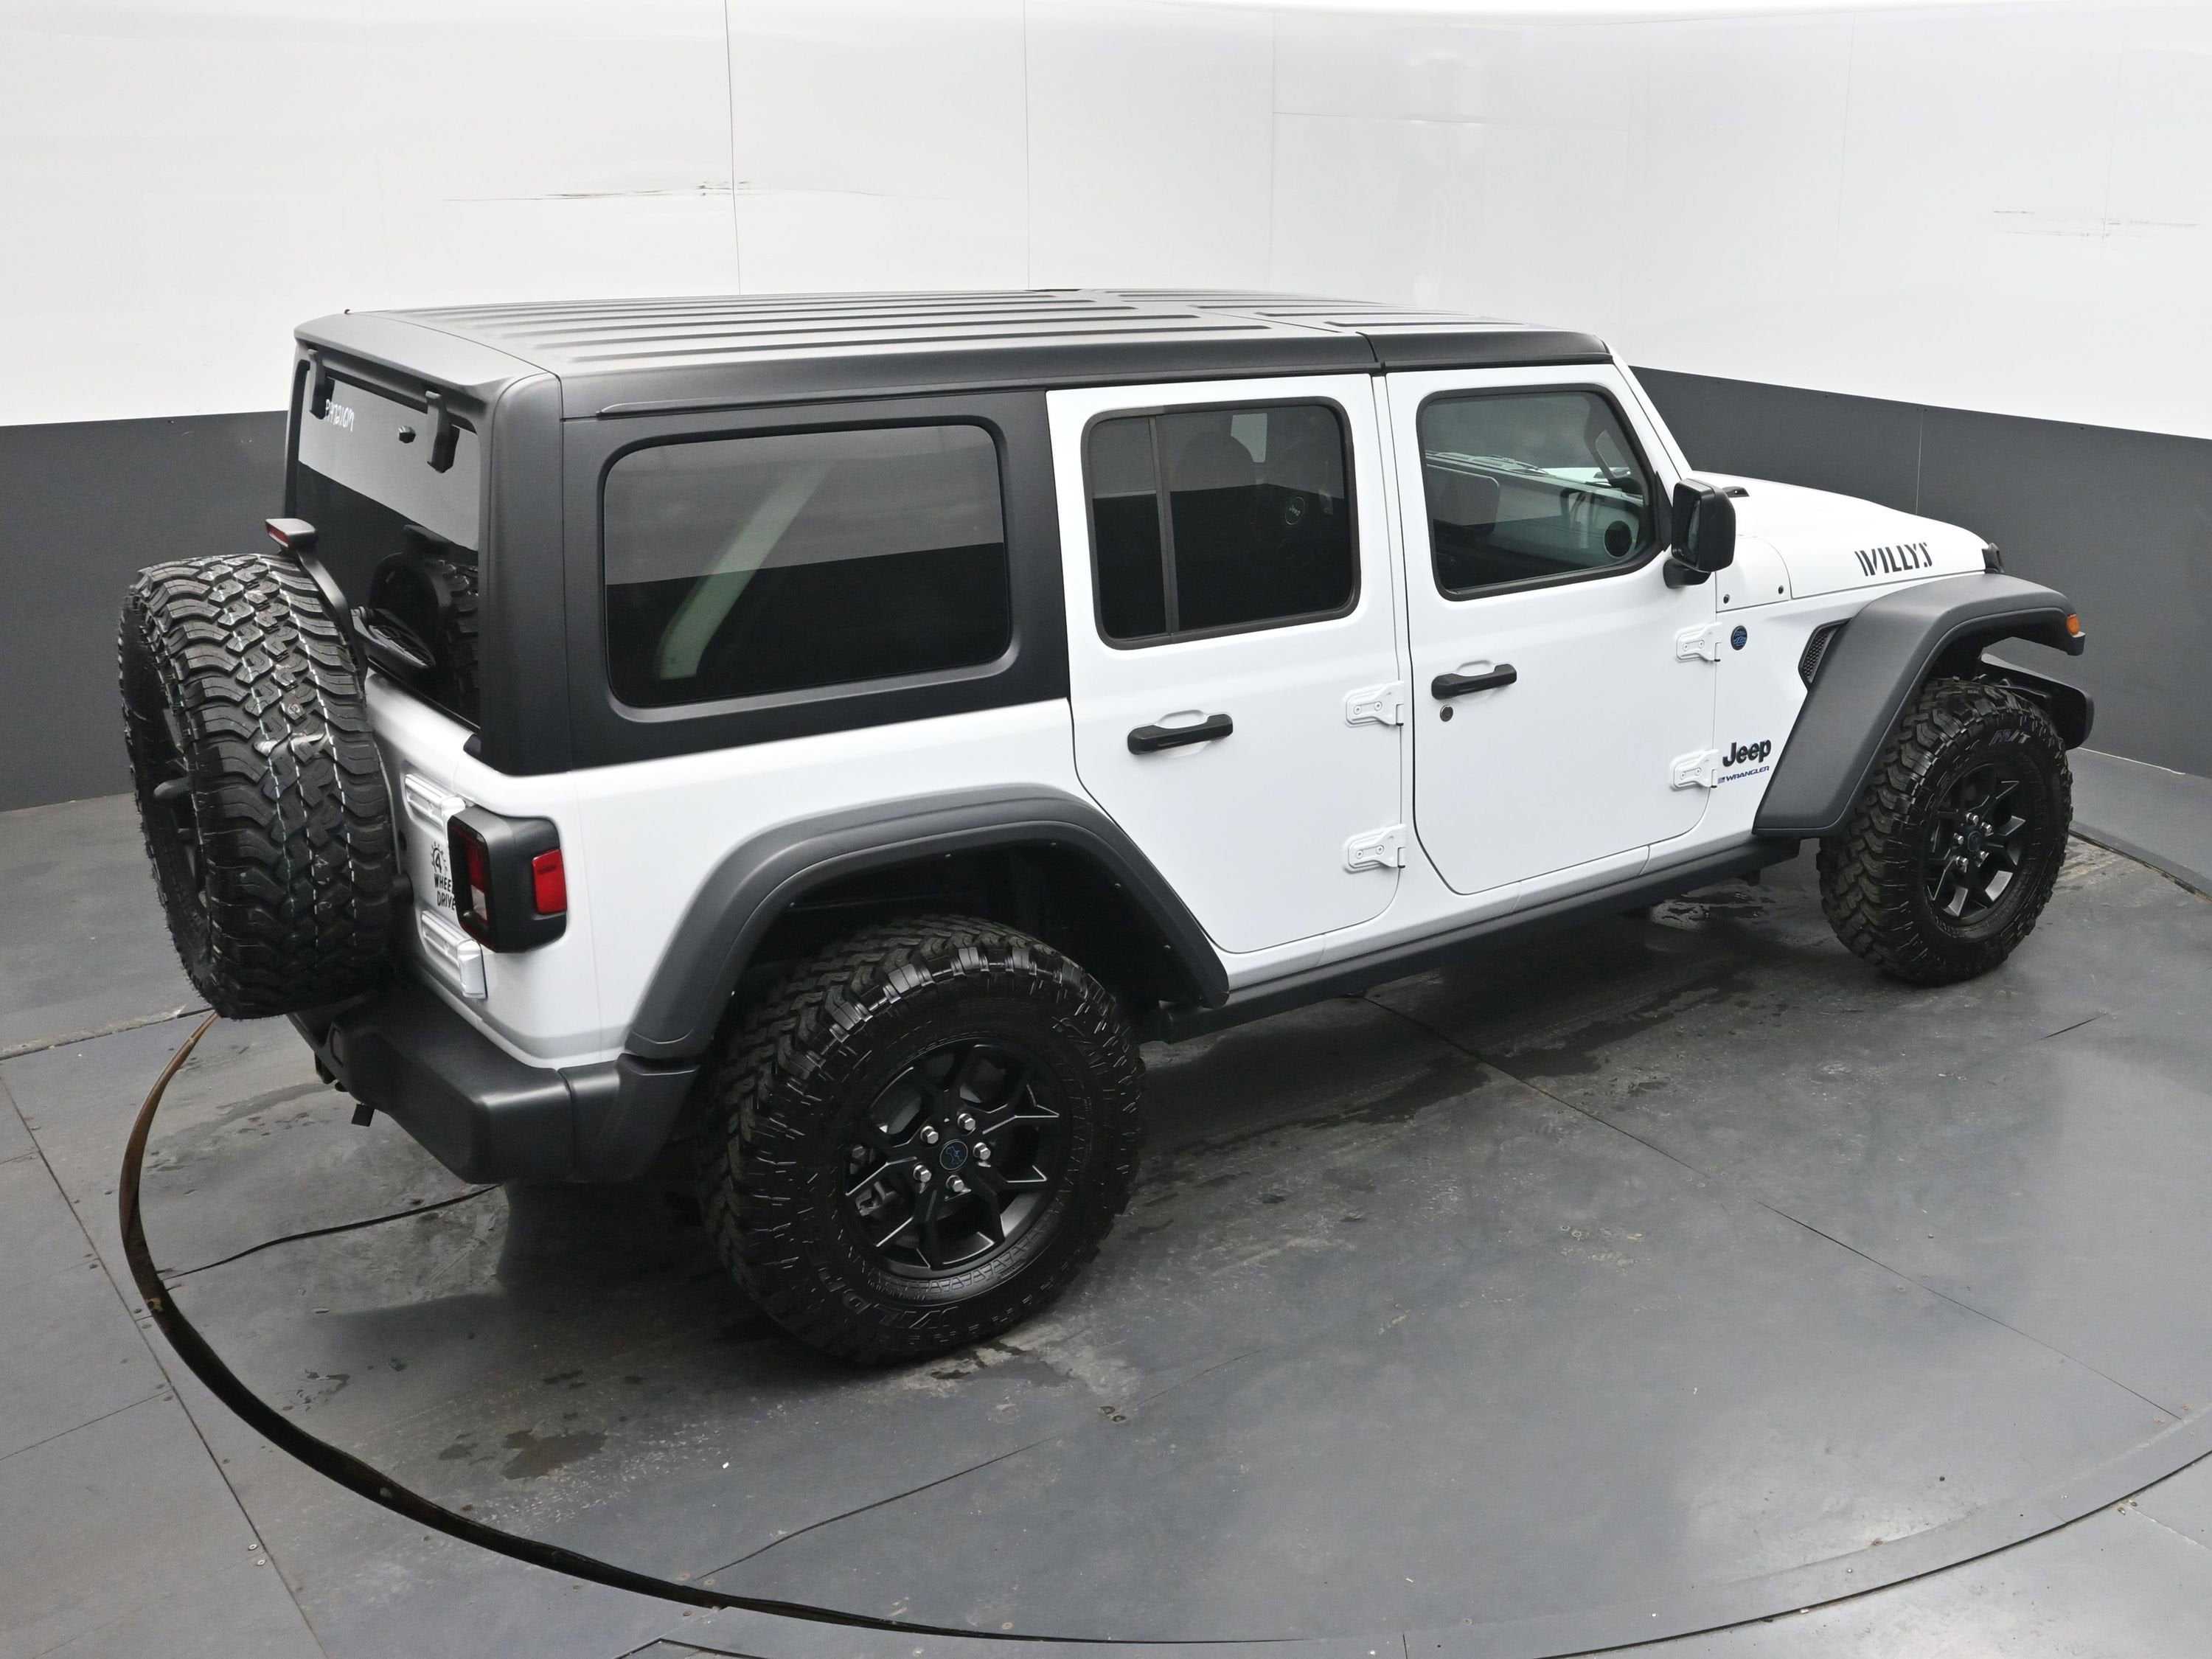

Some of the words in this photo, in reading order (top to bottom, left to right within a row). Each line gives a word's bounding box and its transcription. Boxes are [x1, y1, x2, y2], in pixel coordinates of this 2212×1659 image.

[1289, 504, 1301, 516] Jeep
[1854, 542, 1933, 577] WILLYS
[1722, 739, 1772, 767] Jeep
[1726, 765, 1770, 782] WRANGLER
[435, 852, 442, 874] 4
[434, 873, 452, 893] WHEE
